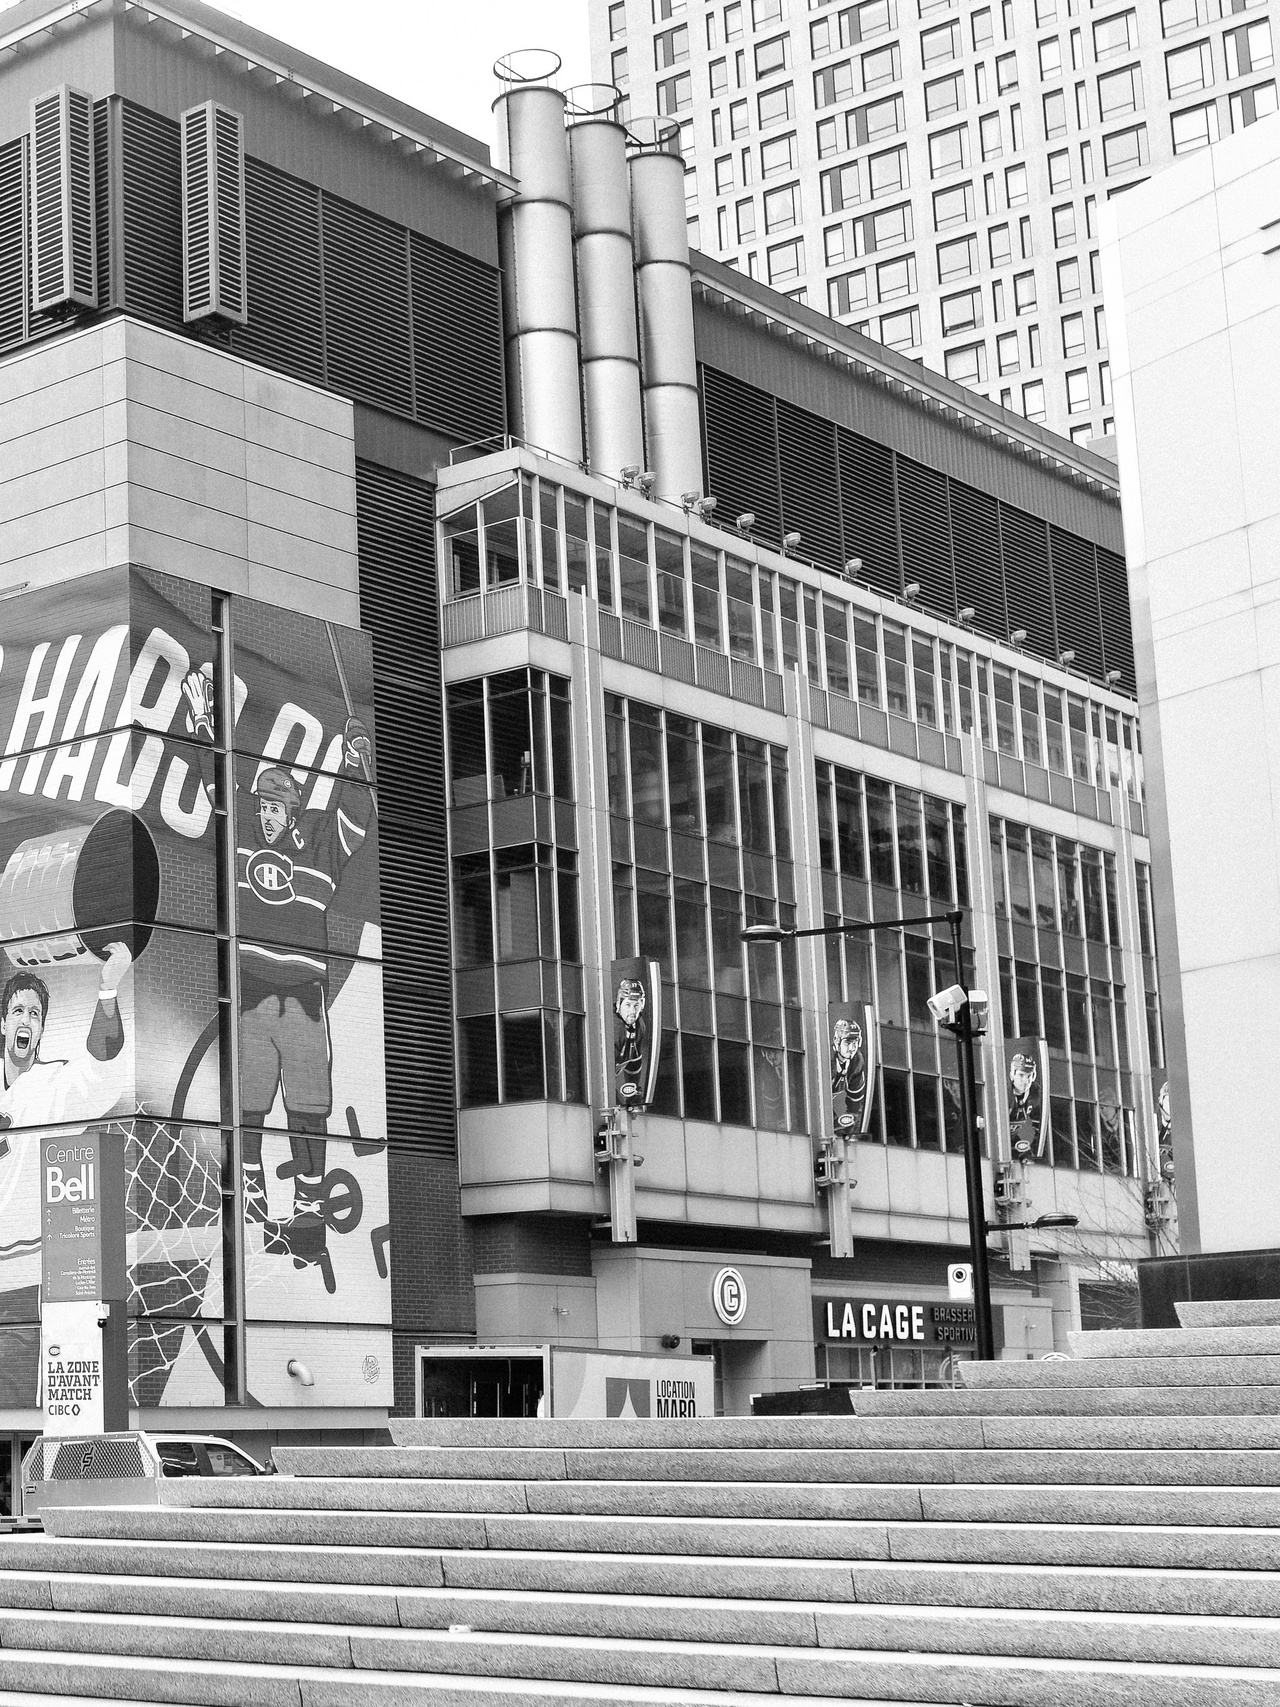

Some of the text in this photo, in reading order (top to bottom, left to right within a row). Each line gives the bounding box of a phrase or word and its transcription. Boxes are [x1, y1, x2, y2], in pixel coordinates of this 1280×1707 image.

[45, 1143, 94, 1164] Centre
[46, 1163, 95, 1203] Bell
[827, 1302, 925, 1340] LA CAGE
[934, 1307, 976, 1322] BRASSERI
[47, 1360, 99, 1374] LA ZONE
[47, 1388, 92, 1401] MATCH
[656, 1379, 696, 1399] LOCATION
[48, 1404, 71, 1416] CIBC
